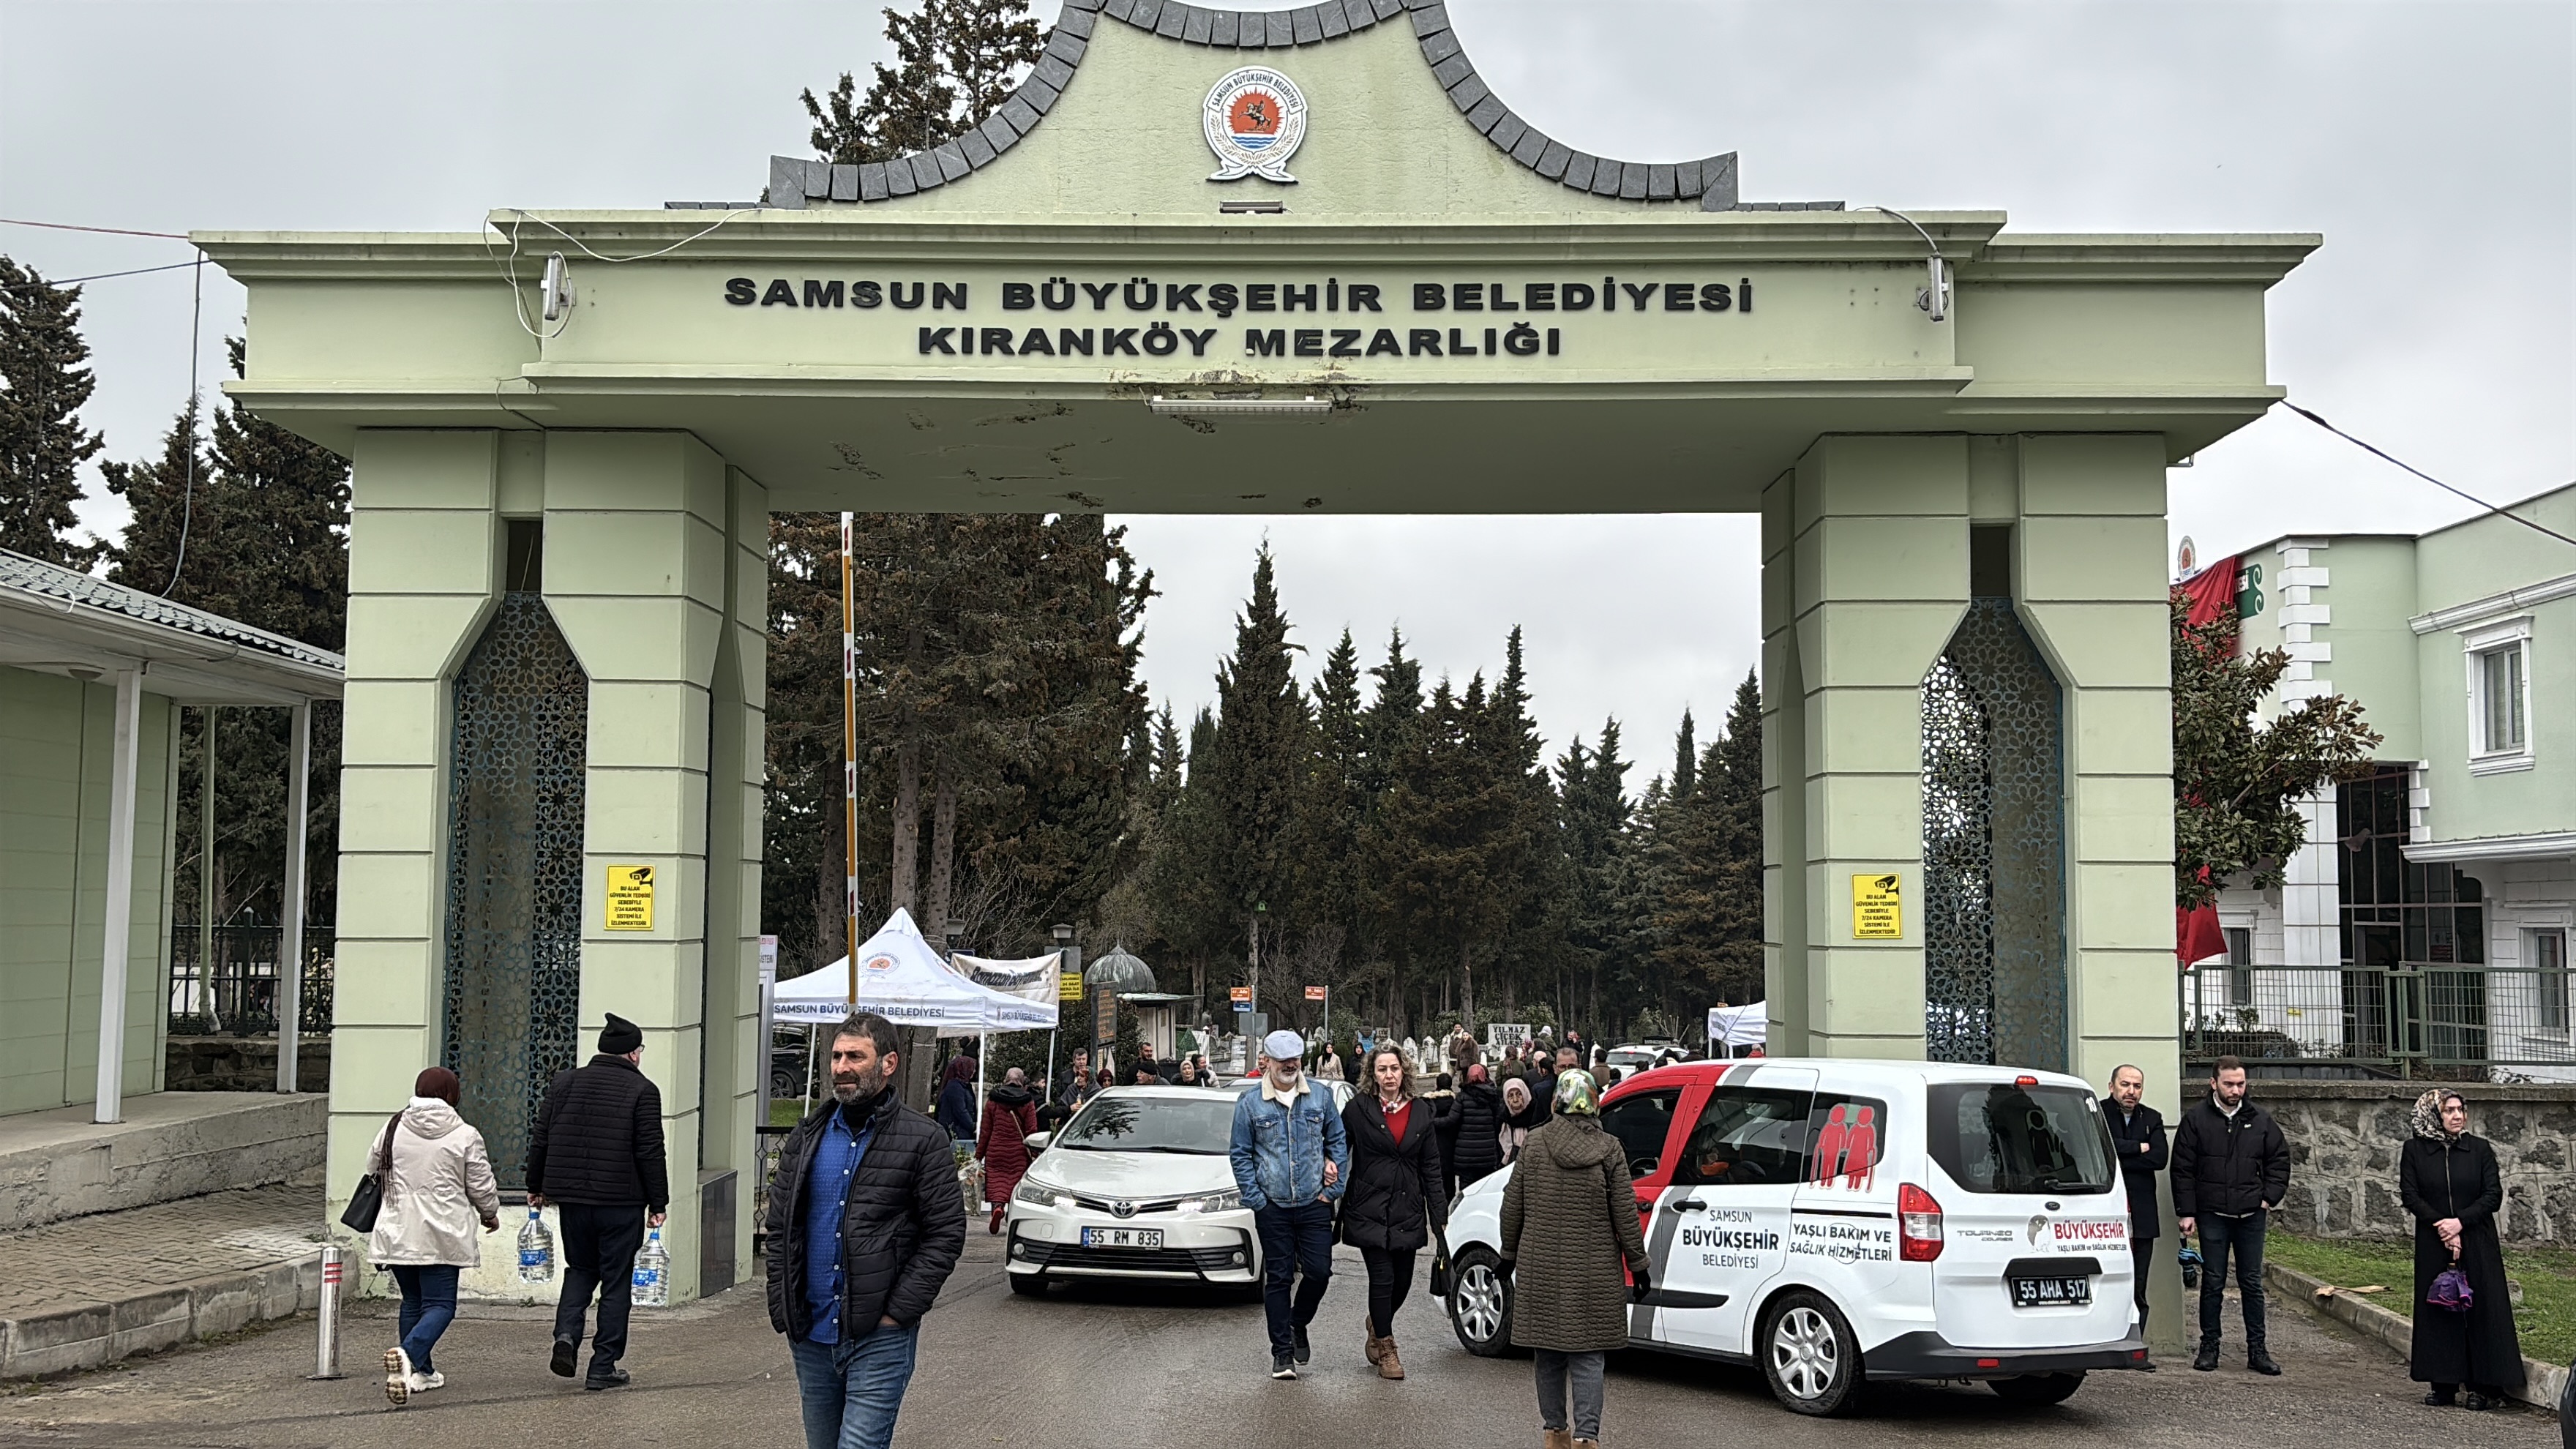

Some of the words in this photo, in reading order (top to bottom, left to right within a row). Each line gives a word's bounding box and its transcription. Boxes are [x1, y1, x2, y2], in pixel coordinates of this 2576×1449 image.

[1212, 81, 1234, 107] SAMSUN
[1233, 71, 1274, 86] BÜYÜKŞEHİR
[1273, 79, 1302, 108] BELEDİYESİ
[724, 277, 967, 310] SAMSUN
[1002, 277, 1382, 318] BÜYÜKŞEHİR
[1413, 276, 1753, 312] BELEDİYESİ
[918, 321, 1217, 356] KIRANKÖY
[1246, 321, 1560, 356] MEZARLIĞI
[774, 1004, 817, 1014] SAMSUN
[888, 1006, 945, 1018] BELEDİYESİ
[1710, 1210, 1752, 1223] SAMSUN
[1090, 1230, 1104, 1243] 55
[1114, 1231, 1128, 1244] RM
[1138, 1232, 1159, 1246] 835
[1683, 1226, 1779, 1251] BÜYÜKŞEHİR
[1793, 1224, 1826, 1239] YAŞLI
[1830, 1226, 1870, 1241] BAKIM
[1874, 1230, 1891, 1243] VE
[2054, 1218, 2125, 1240] BÜYÜKŞEHİR
[1790, 1240, 1825, 1256] SAĞLIK
[1828, 1244, 1892, 1262] HİZMETLERİ
[2057, 1245, 2070, 1254] YAŞLI
[1702, 1253, 1759, 1269] BELEDİYESİ
[2020, 1281, 2037, 1299] 55
[2040, 1280, 2063, 1298] AHA
[2066, 1279, 2086, 1298] 517
